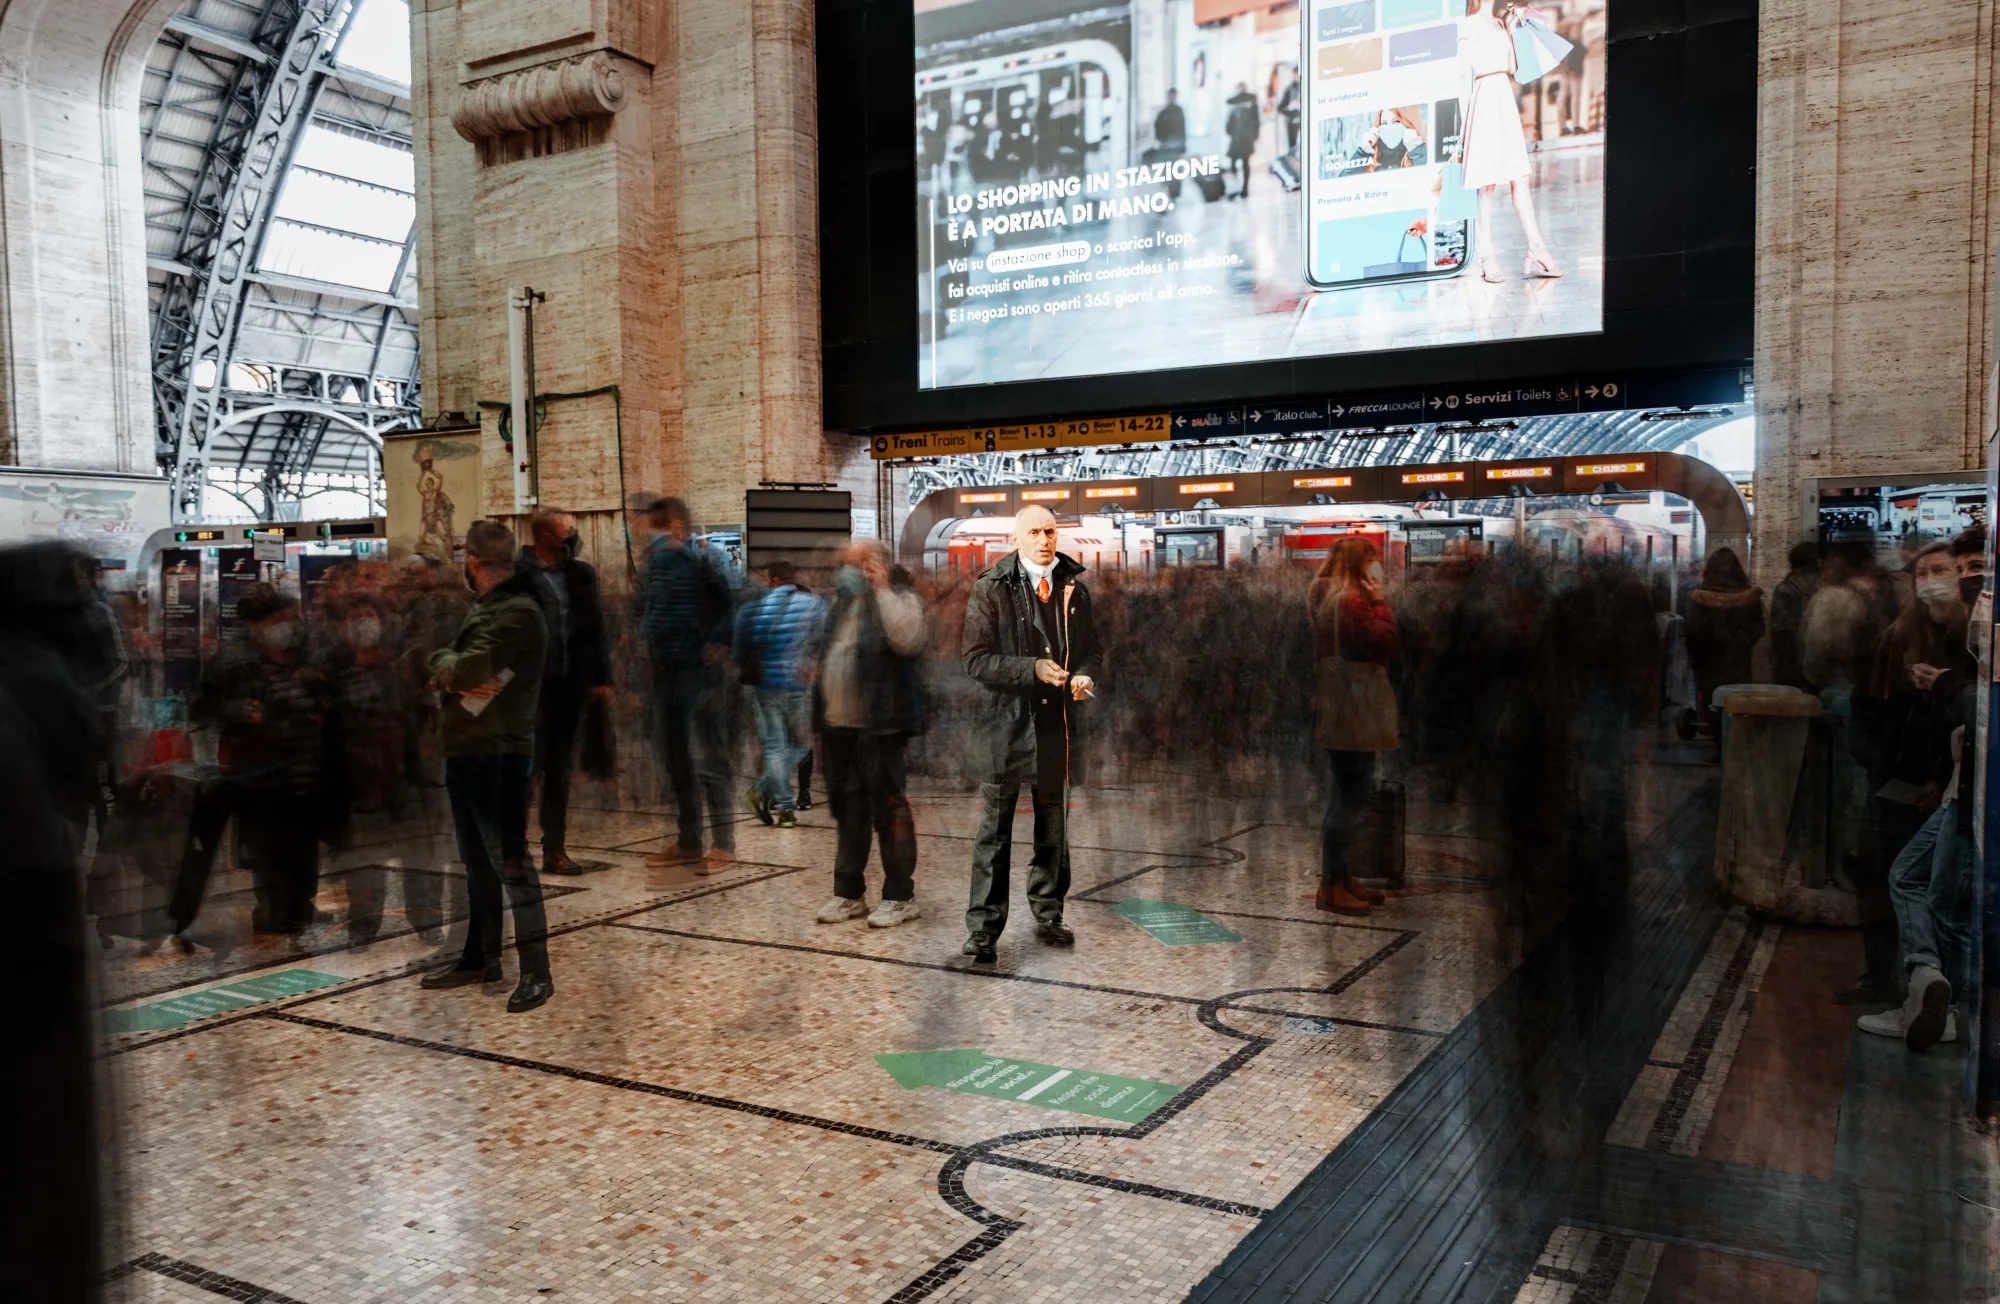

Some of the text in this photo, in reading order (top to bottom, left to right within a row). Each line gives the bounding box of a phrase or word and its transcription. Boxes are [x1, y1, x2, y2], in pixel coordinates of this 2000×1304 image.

[1328, 90, 1369, 103] evidenza
[947, 154, 1220, 215] LO SHOPPING IN STAZIONE
[1317, 194, 1352, 205] Prenota
[1364, 189, 1389, 199] Ritira
[962, 219, 978, 239] A
[982, 206, 1068, 237] PORTATA
[1072, 202, 1093, 224] DI
[1098, 192, 1175, 221] MANO.
[948, 258, 968, 274] Vai
[970, 260, 983, 272] su
[991, 251, 1052, 267] instazione
[1056, 245, 1086, 259] shop
[1093, 244, 1103, 255] o
[1107, 236, 1153, 253] scarica
[948, 283, 964, 299] fai
[966, 278, 1010, 298] acquisti
[1012, 274, 1049, 291] online
[1051, 275, 1061, 287] e
[1063, 269, 1092, 285] ritira
[1096, 260, 1164, 281] contactless
[1167, 258, 1179, 272] in
[948, 309, 958, 323] E
[967, 303, 1008, 323] negozi
[1010, 304, 1041, 317] sono
[1043, 296, 1081, 316] aperti
[1084, 291, 1111, 309] 365
[1115, 289, 1153, 309] giorni
[1465, 388, 1552, 405] Servizi Toilets
[1119, 416, 1165, 433] 14-22
[1299, 410, 1318, 419] Club
[892, 434, 928, 449] Treni
[931, 432, 966, 447] Trains
[1024, 424, 1056, 440] 1-13
[1711, 538, 1741, 547] GATE
